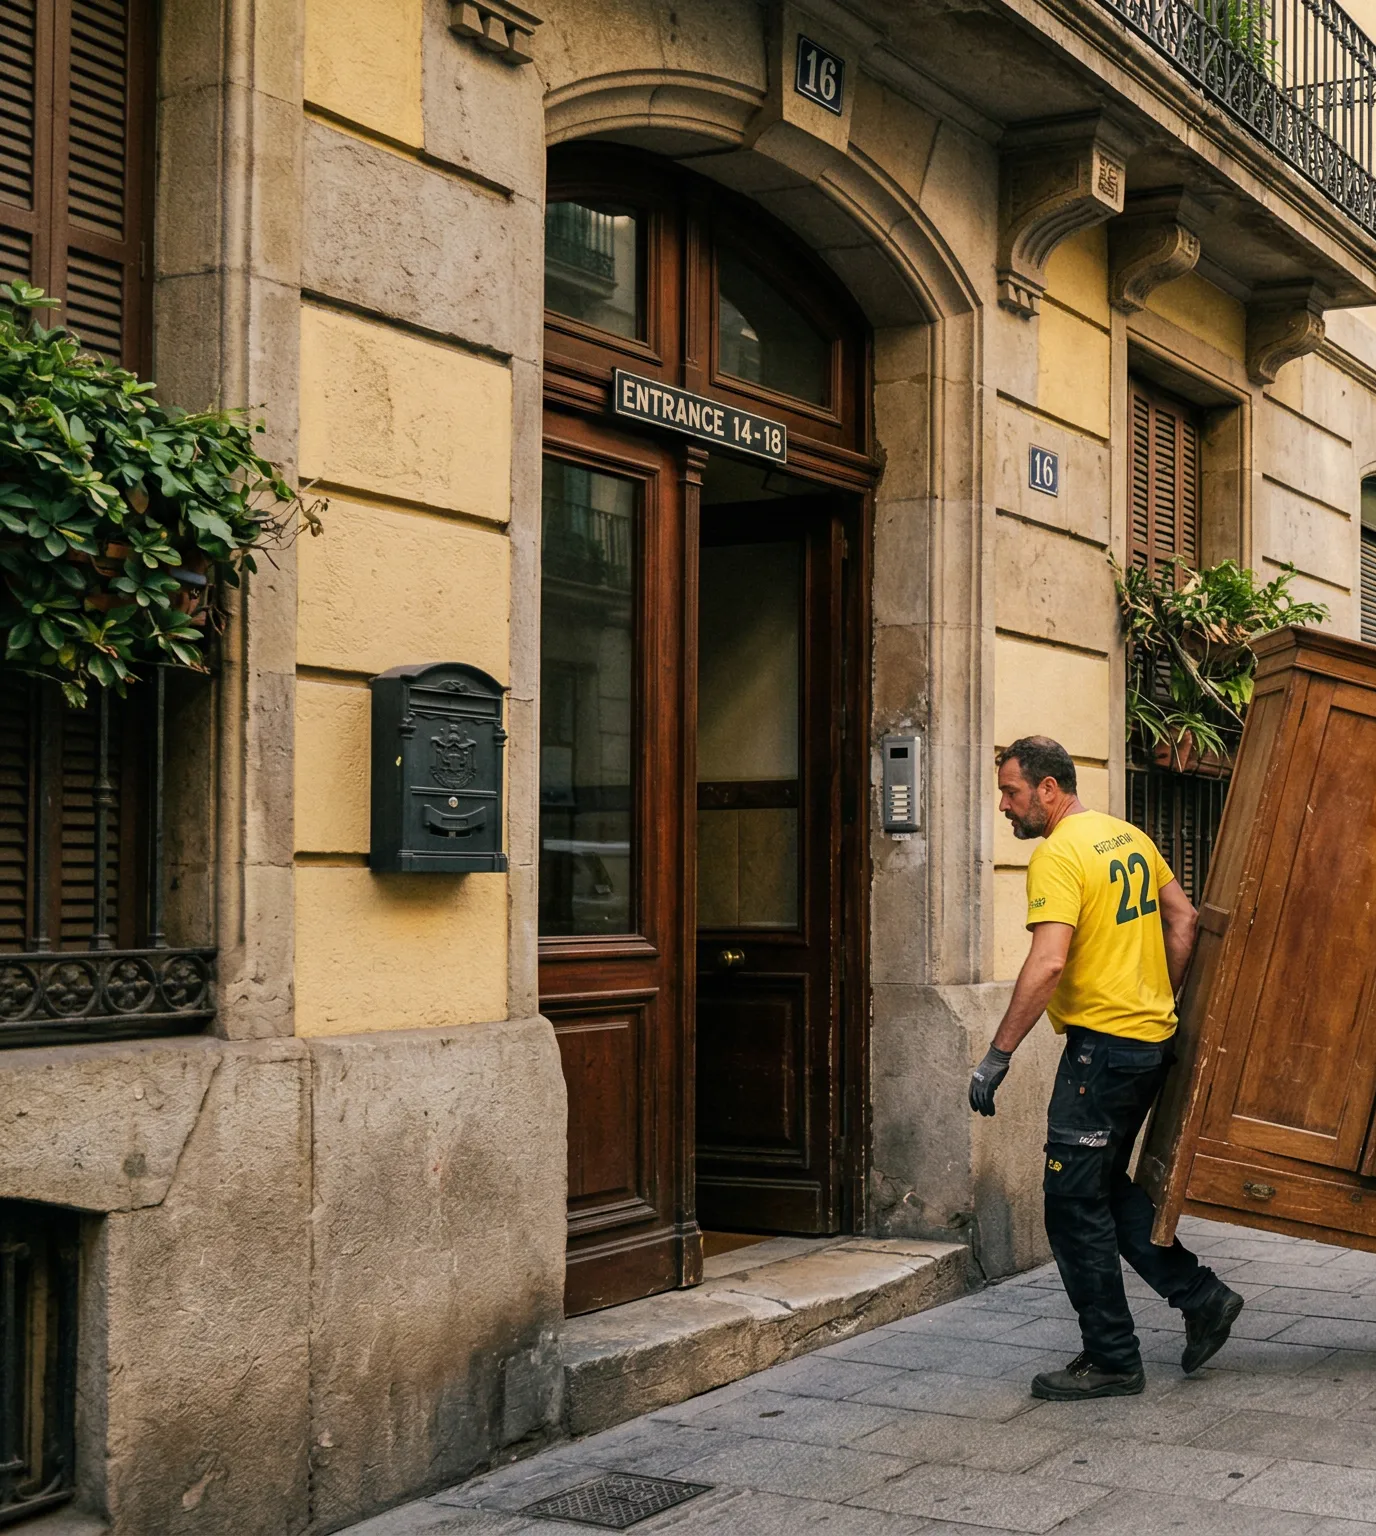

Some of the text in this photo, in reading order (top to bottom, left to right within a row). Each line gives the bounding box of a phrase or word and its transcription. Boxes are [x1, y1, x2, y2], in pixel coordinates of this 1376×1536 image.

[805, 49, 836, 100] 16
[623, 379, 782, 454] ENTRANCE 14-18
[1035, 452, 1053, 487] 16
[1109, 852, 1157, 925] 22
